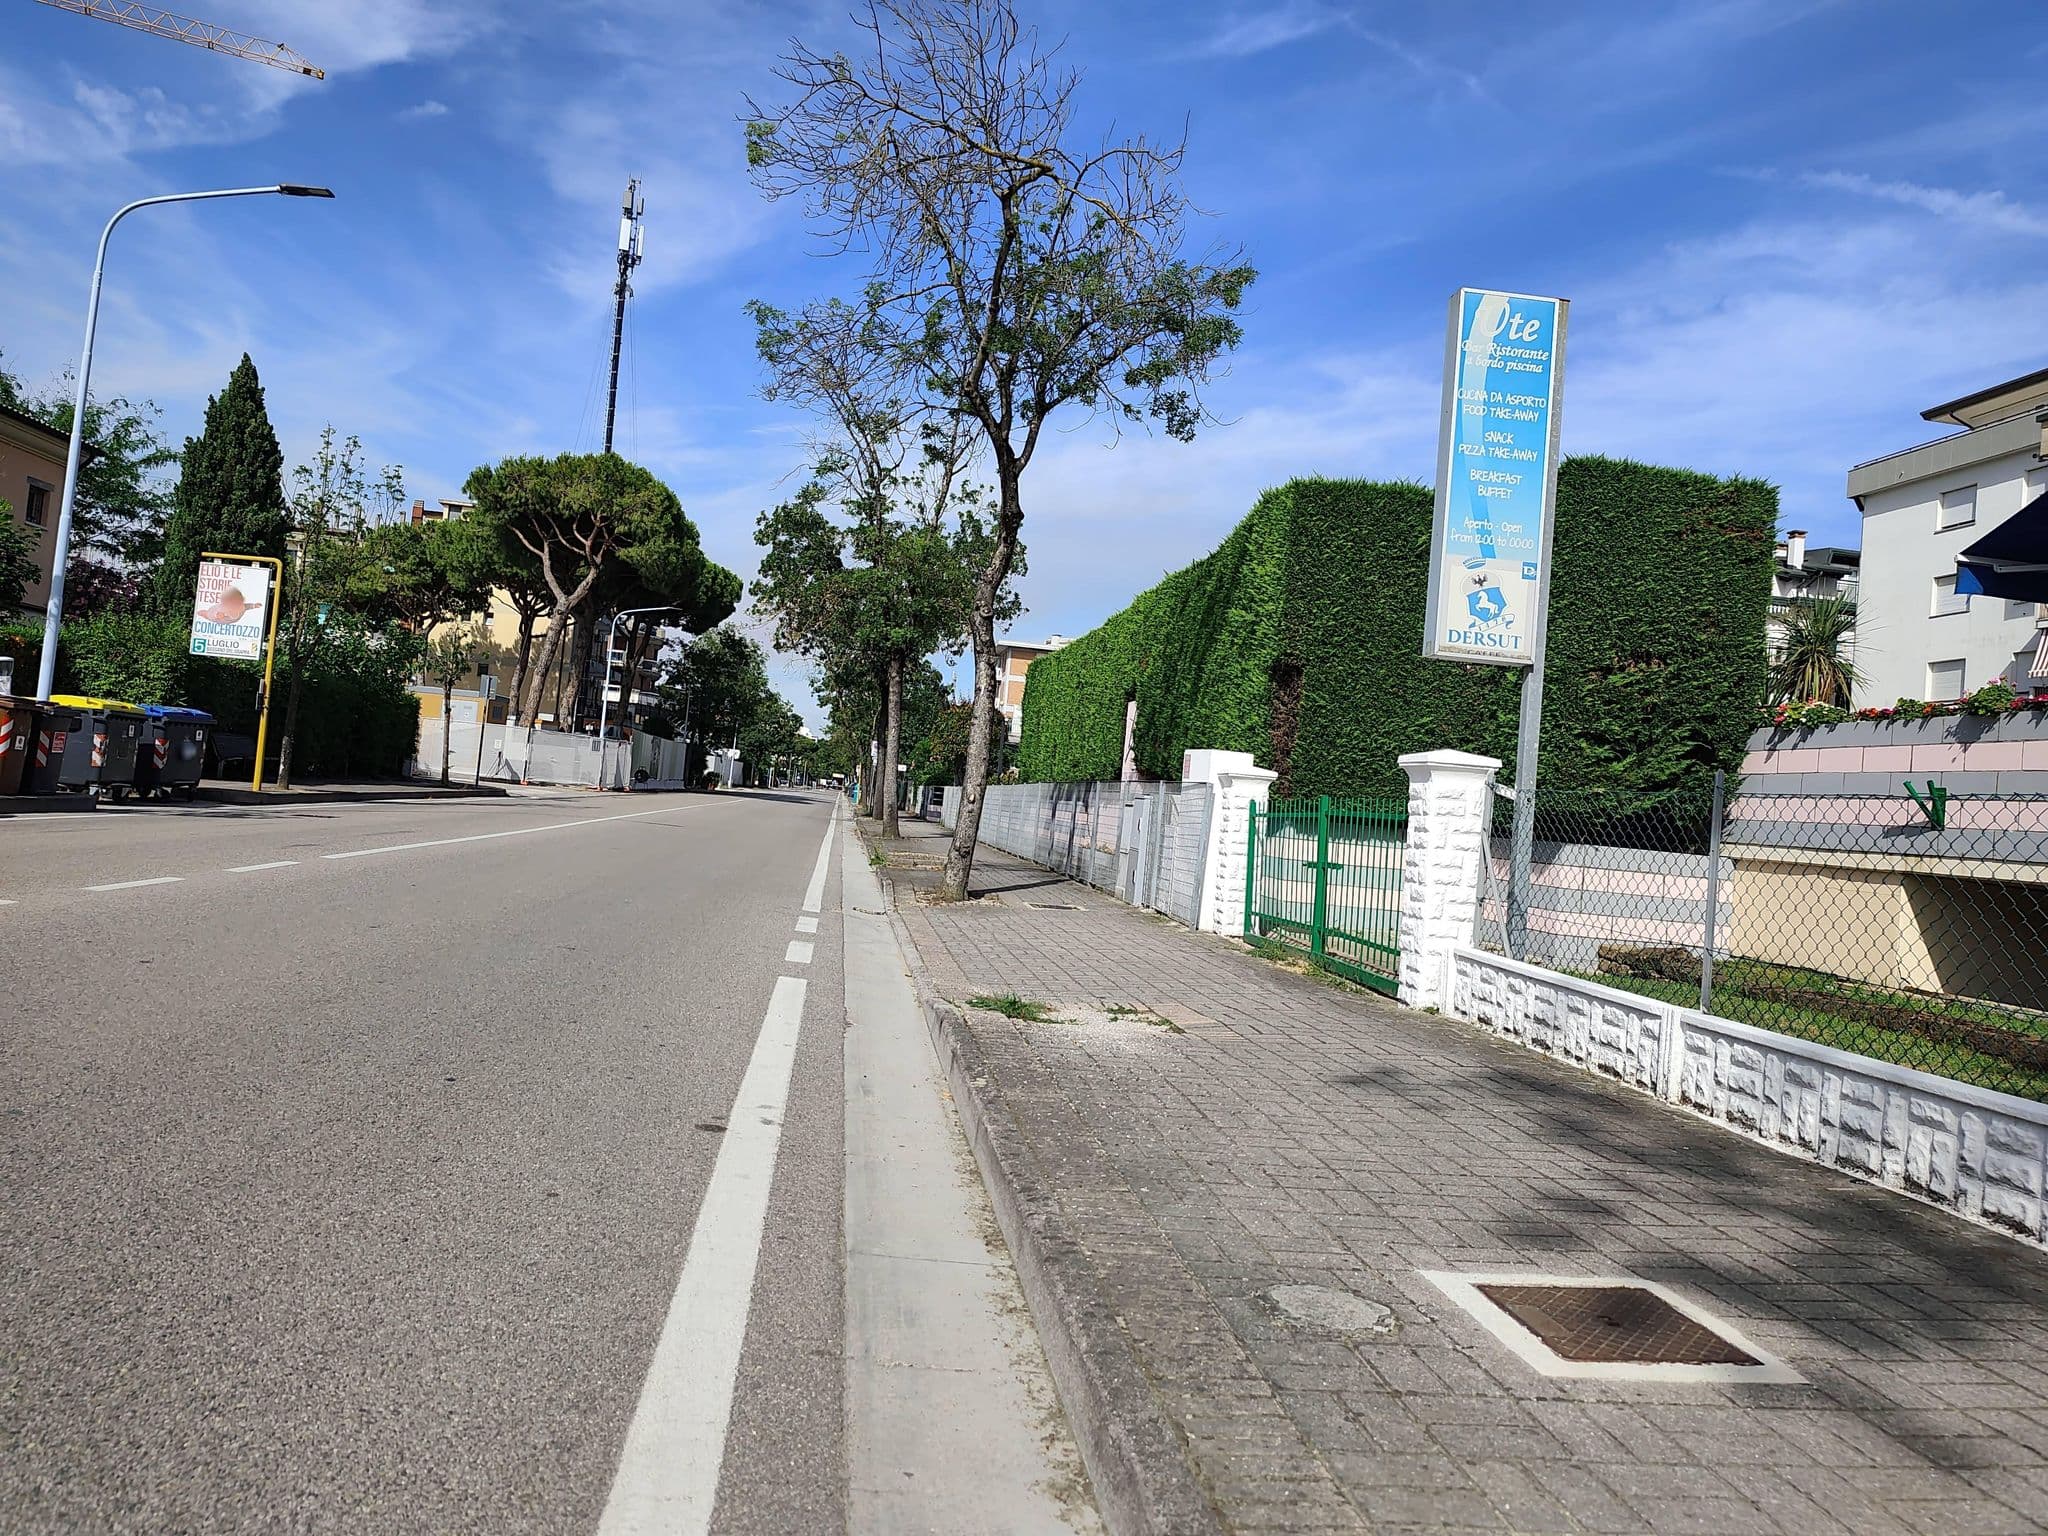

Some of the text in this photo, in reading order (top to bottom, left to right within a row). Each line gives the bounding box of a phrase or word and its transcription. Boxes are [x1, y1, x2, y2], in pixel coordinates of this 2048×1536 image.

[1487, 342, 1550, 361] Ristorante
[1475, 355, 1504, 369] bordo
[1505, 360, 1543, 374] piscina
[1458, 388, 1547, 408] CUCINA DA ASPORTO
[1463, 404, 1540, 423] FOOD TAKE-AWAY
[1484, 430, 1514, 445] SNACK
[1458, 443, 1538, 463] PIZZA TAKE-AWAY
[1470, 468, 1523, 486] BREAKFAST
[1477, 484, 1513, 499] BUFFET
[1463, 516, 1493, 533] Aperto
[1501, 521, 1523, 537] Open
[1450, 527, 1473, 544] from
[1497, 535, 1507, 548] to
[200, 564, 242, 580] ELIO E LE
[199, 590, 221, 604] TESE
[194, 621, 260, 639] CONCERTOZZO
[1448, 629, 1522, 649] DERSUT
[194, 639, 205, 653] 5
[207, 639, 240, 649] LUGLIO
